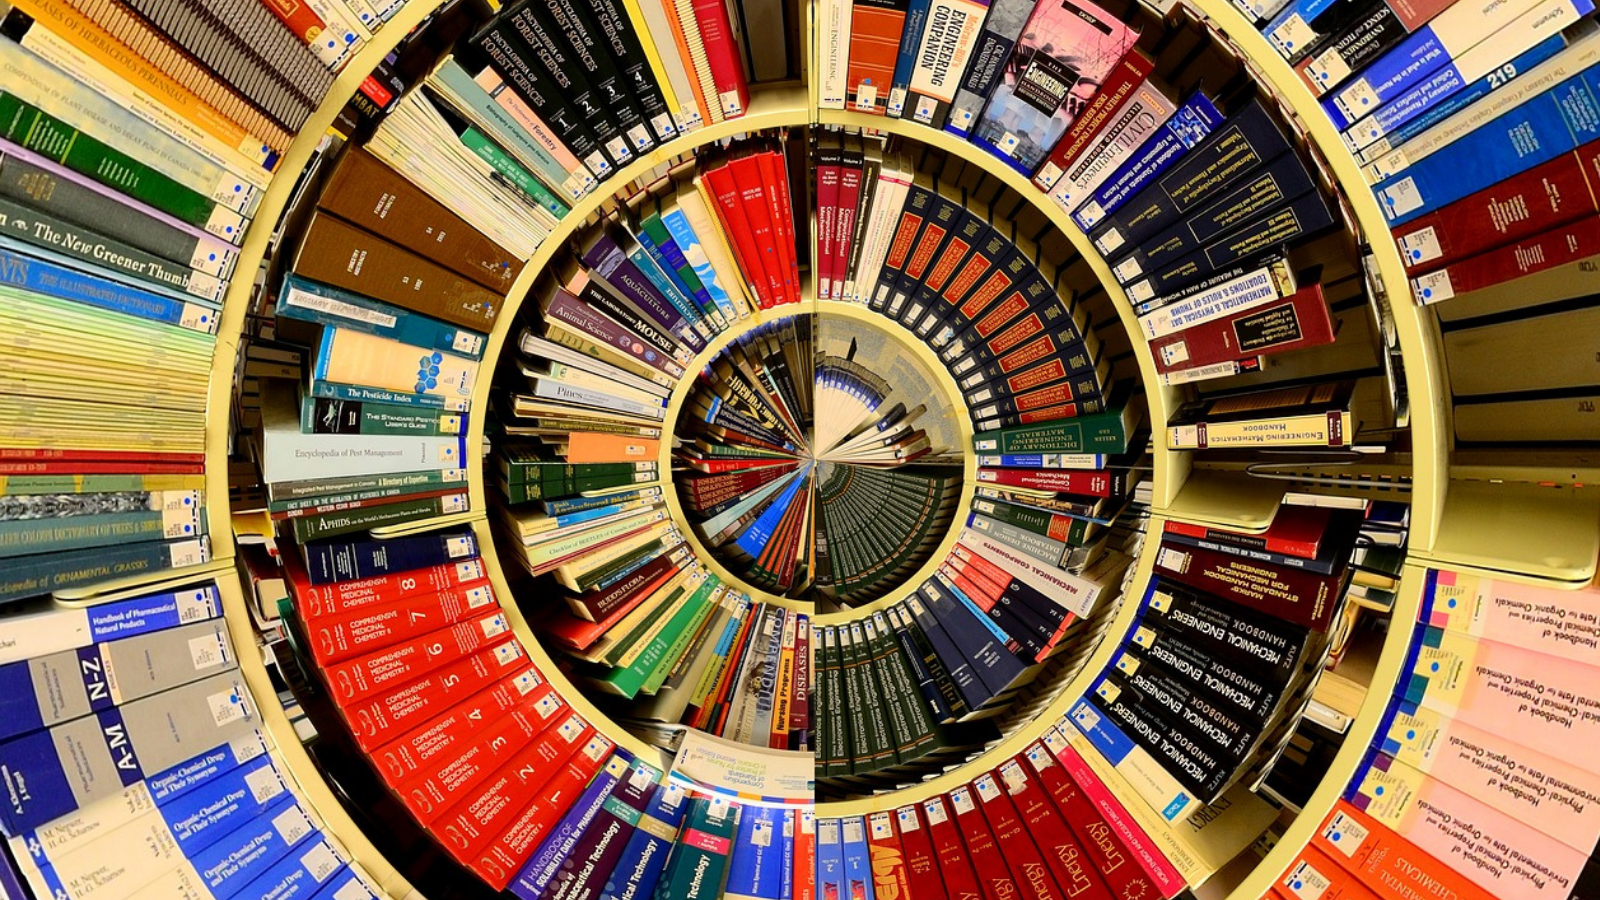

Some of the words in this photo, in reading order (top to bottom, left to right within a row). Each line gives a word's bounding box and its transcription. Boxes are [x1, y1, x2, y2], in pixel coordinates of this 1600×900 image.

[521, 7, 558, 54] ENCYCLOPEDIA
[555, 51, 565, 62] OF
[921, 5, 950, 70] COMPANION
[931, 9, 966, 86] ENGINEERING
[66, 19, 80, 33] OF
[80, 26, 137, 71] HERBACEOUS
[138, 66, 188, 105] PERENNIALS
[490, 30, 529, 73] ENCYCLOPEDIA
[528, 71, 537, 82] OF
[511, 14, 542, 49] FOREST
[538, 46, 570, 88] SCIENCES
[481, 37, 514, 71] FOREST
[509, 69, 546, 107] SCIENCES
[1024, 61, 1069, 100] ENGINEERING
[1486, 62, 1517, 89] 219
[1119, 80, 1132, 94] THE
[1094, 93, 1109, 109] DESK
[1104, 93, 1122, 110] WILEY
[1087, 110, 1108, 134] PROJECT
[1122, 111, 1156, 155] CIVIL
[533, 124, 557, 150] Forestry
[1076, 140, 1125, 190] Engineer's
[34, 222, 61, 244] The
[61, 234, 92, 254] New
[94, 245, 146, 272] Greener
[148, 263, 188, 287] Thumb
[620, 273, 670, 320] AQUACULTURE
[1201, 290, 1222, 302] RULES
[1230, 274, 1268, 293] EQUATIONS
[1171, 301, 1190, 316] THUMB
[1191, 298, 1200, 307] OF
[1225, 286, 1272, 311] MATHEMATICAL
[556, 306, 585, 326] Animal
[586, 320, 614, 340] Science
[590, 290, 602, 300] THE
[634, 320, 673, 351] MOUSE
[1186, 306, 1216, 322] PHYSICAL
[348, 388, 360, 398] The
[362, 390, 391, 401] Pesticide
[392, 393, 412, 403] Index
[557, 387, 582, 399] Pines
[366, 413, 380, 421] THE
[381, 413, 414, 422] STANDARD
[408, 422, 426, 430] GUIDE
[1012, 435, 1074, 443] ENGINEERING
[1024, 441, 1077, 450] DICTIONARY
[1266, 431, 1323, 441] ENGINEERING
[295, 450, 339, 458] Encyclopedia
[350, 449, 362, 458] Pest
[364, 450, 402, 458] Management
[319, 517, 350, 530] APHIDS
[983, 542, 1028, 570] COMPONENTS
[54, 565, 110, 584] ORNAMENTAL
[114, 560, 148, 572] GRASSES
[1028, 566, 1078, 594] MECHANICAL
[1204, 570, 1252, 589] HANDBOOK
[1217, 566, 1269, 584] MECHANICAL
[1230, 562, 1278, 578] ENGINEERS
[340, 577, 387, 591] COMPREHENSIVE
[341, 590, 374, 600] MEDICINAL
[401, 580, 416, 590] 8
[598, 588, 626, 609] BUDD'S
[622, 574, 645, 592] FLORA
[1252, 584, 1298, 602] STANDARD
[1271, 581, 1288, 590] FOR
[92, 610, 124, 626] Handbook
[125, 609, 133, 620] of
[134, 602, 176, 618] Pharmaceutical
[342, 596, 374, 608] CHEMISTRY
[95, 622, 118, 634] Natural
[119, 619, 145, 632] Products
[411, 610, 426, 622] 7
[1168, 609, 1226, 640] ENGINEERS'
[1233, 620, 1286, 648] HANDBOOK
[368, 646, 414, 668] COMPREHENSIVE
[428, 643, 442, 655] 6
[1228, 632, 1280, 664] MECHANICAL
[1283, 645, 1297, 668] KUTZ
[370, 661, 403, 676] MEDICINAL
[780, 658, 790, 693] Programs
[796, 645, 808, 701] DISEASES
[1148, 645, 1202, 680] ENGINEERS'
[82, 655, 108, 701] N-Z
[374, 669, 404, 684] CHEMISTRY
[446, 674, 460, 688] 5
[1210, 662, 1262, 694] HANDBOOK
[832, 670, 841, 711] Engineering
[1130, 674, 1183, 714] ENGINEERS'
[1204, 674, 1256, 711] MECHANICAL
[468, 708, 482, 720] 4
[776, 694, 788, 730] Nursing
[1190, 697, 1241, 733] HANDBOOK
[1257, 693, 1273, 716] KUTZ
[836, 712, 844, 756] Electronics
[1110, 702, 1160, 746] ENGINEERS'
[1182, 708, 1232, 748] MECHANICAL
[105, 724, 136, 770] A-M
[492, 736, 506, 749] 3
[1168, 729, 1216, 769] HANDBOOK
[1233, 733, 1250, 756] KUTZ
[151, 759, 204, 790] Organic-Chemical
[206, 752, 225, 768] Drugs
[520, 764, 534, 779] 2
[1160, 737, 1207, 782] MECHANICAL
[156, 788, 170, 799] and
[170, 780, 186, 794] Their
[186, 766, 217, 789] Synonyms
[1207, 770, 1226, 790] KUTZ
[469, 778, 508, 814] COMPREHENSIVE
[474, 794, 502, 820] MEDICINAL
[550, 790, 561, 803] 1
[480, 802, 507, 826] CHEMISTRY
[1187, 796, 1232, 832] ENERGY
[1418, 799, 1452, 823] Chemicals
[536, 851, 564, 887] SOLUBILITY
[560, 835, 576, 856] DATA
[577, 779, 616, 830] PHARMACEUTICALS
[594, 820, 621, 862] Technology
[1435, 823, 1476, 851] Properties
[1453, 819, 1482, 840] Organic
[529, 835, 563, 880] HANDBOOK
[562, 822, 573, 837] OF
[1086, 821, 1125, 875] Energy
[1452, 844, 1462, 853] of
[1492, 837, 1510, 854] Fate
[631, 840, 658, 882] Technology
[1055, 843, 1091, 897] Energy
[1464, 851, 1502, 879] Handbook
[1509, 848, 1569, 888] Environmental
[687, 854, 711, 898] Technology
